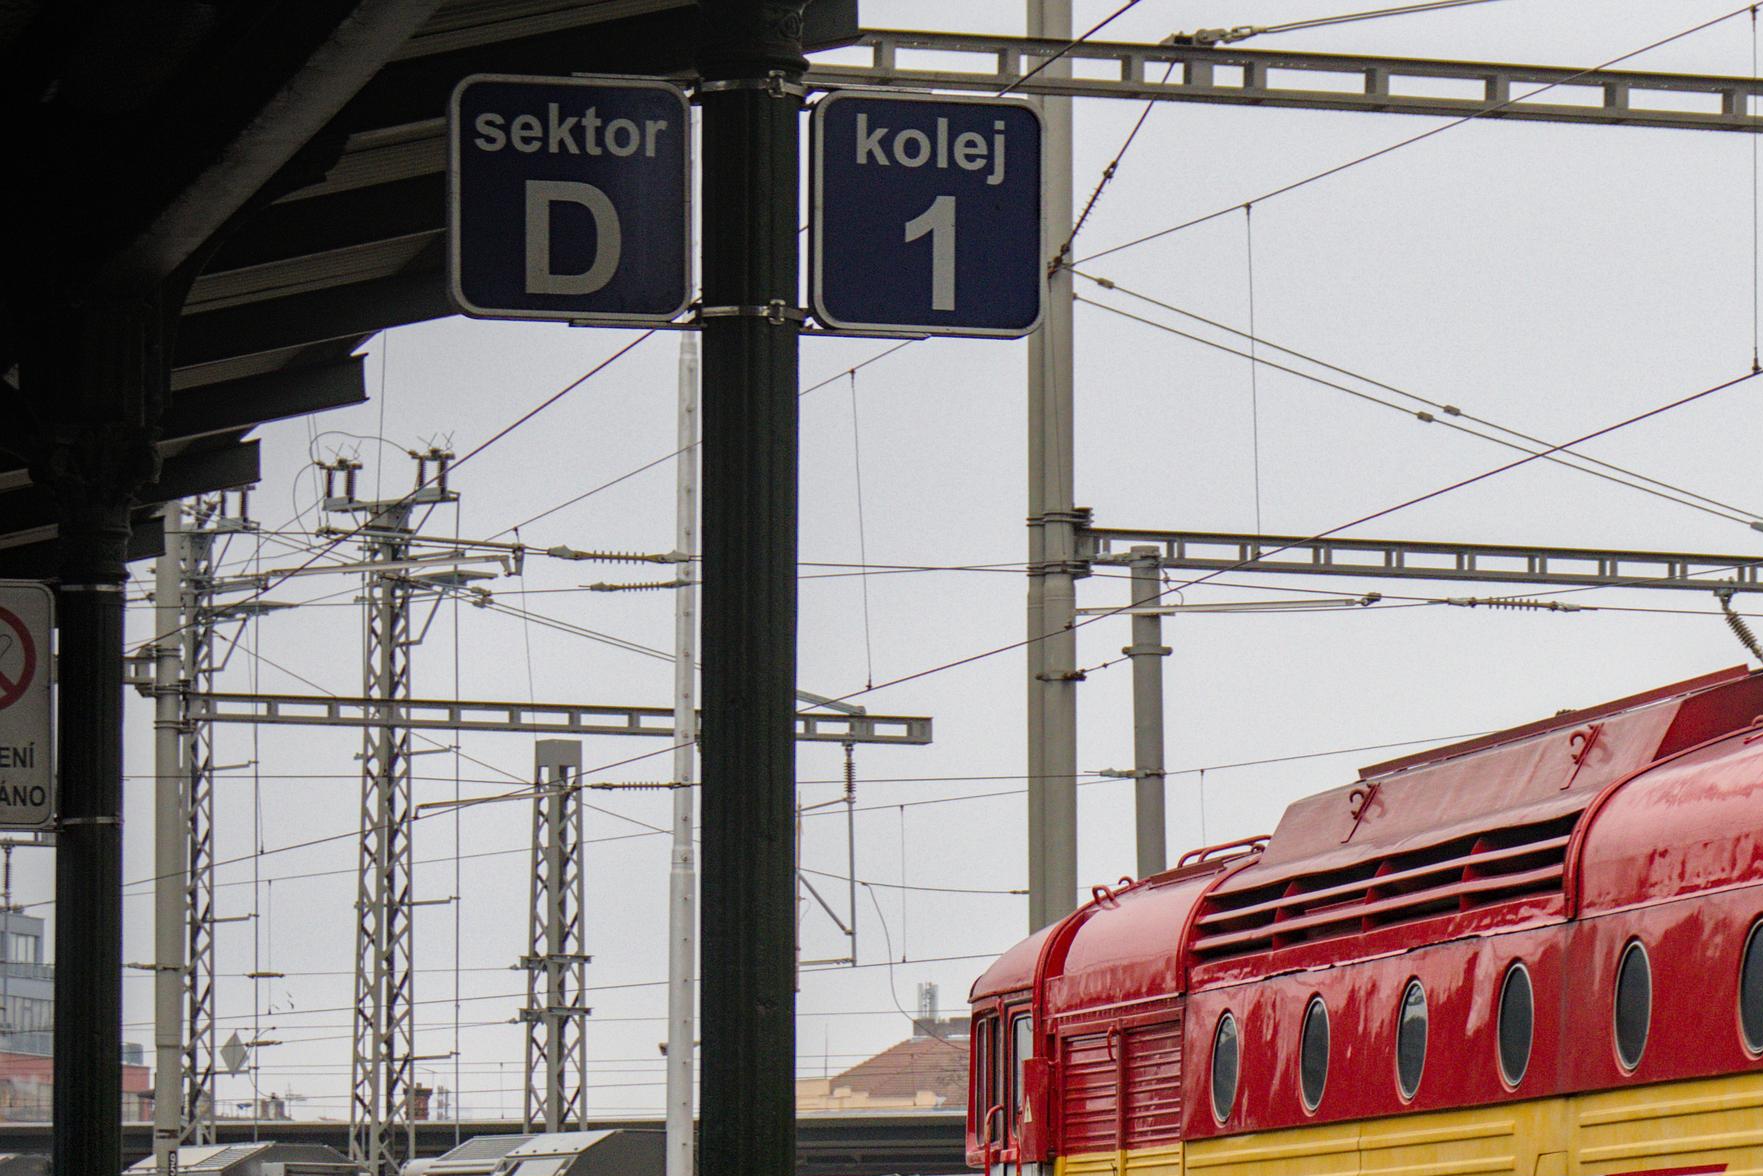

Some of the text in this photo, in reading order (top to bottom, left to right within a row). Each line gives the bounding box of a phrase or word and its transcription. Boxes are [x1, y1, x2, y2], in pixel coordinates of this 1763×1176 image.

[474, 102, 668, 157] sektor
[856, 113, 1005, 186] kolej
[525, 179, 622, 295] D
[905, 195, 956, 311] 1
